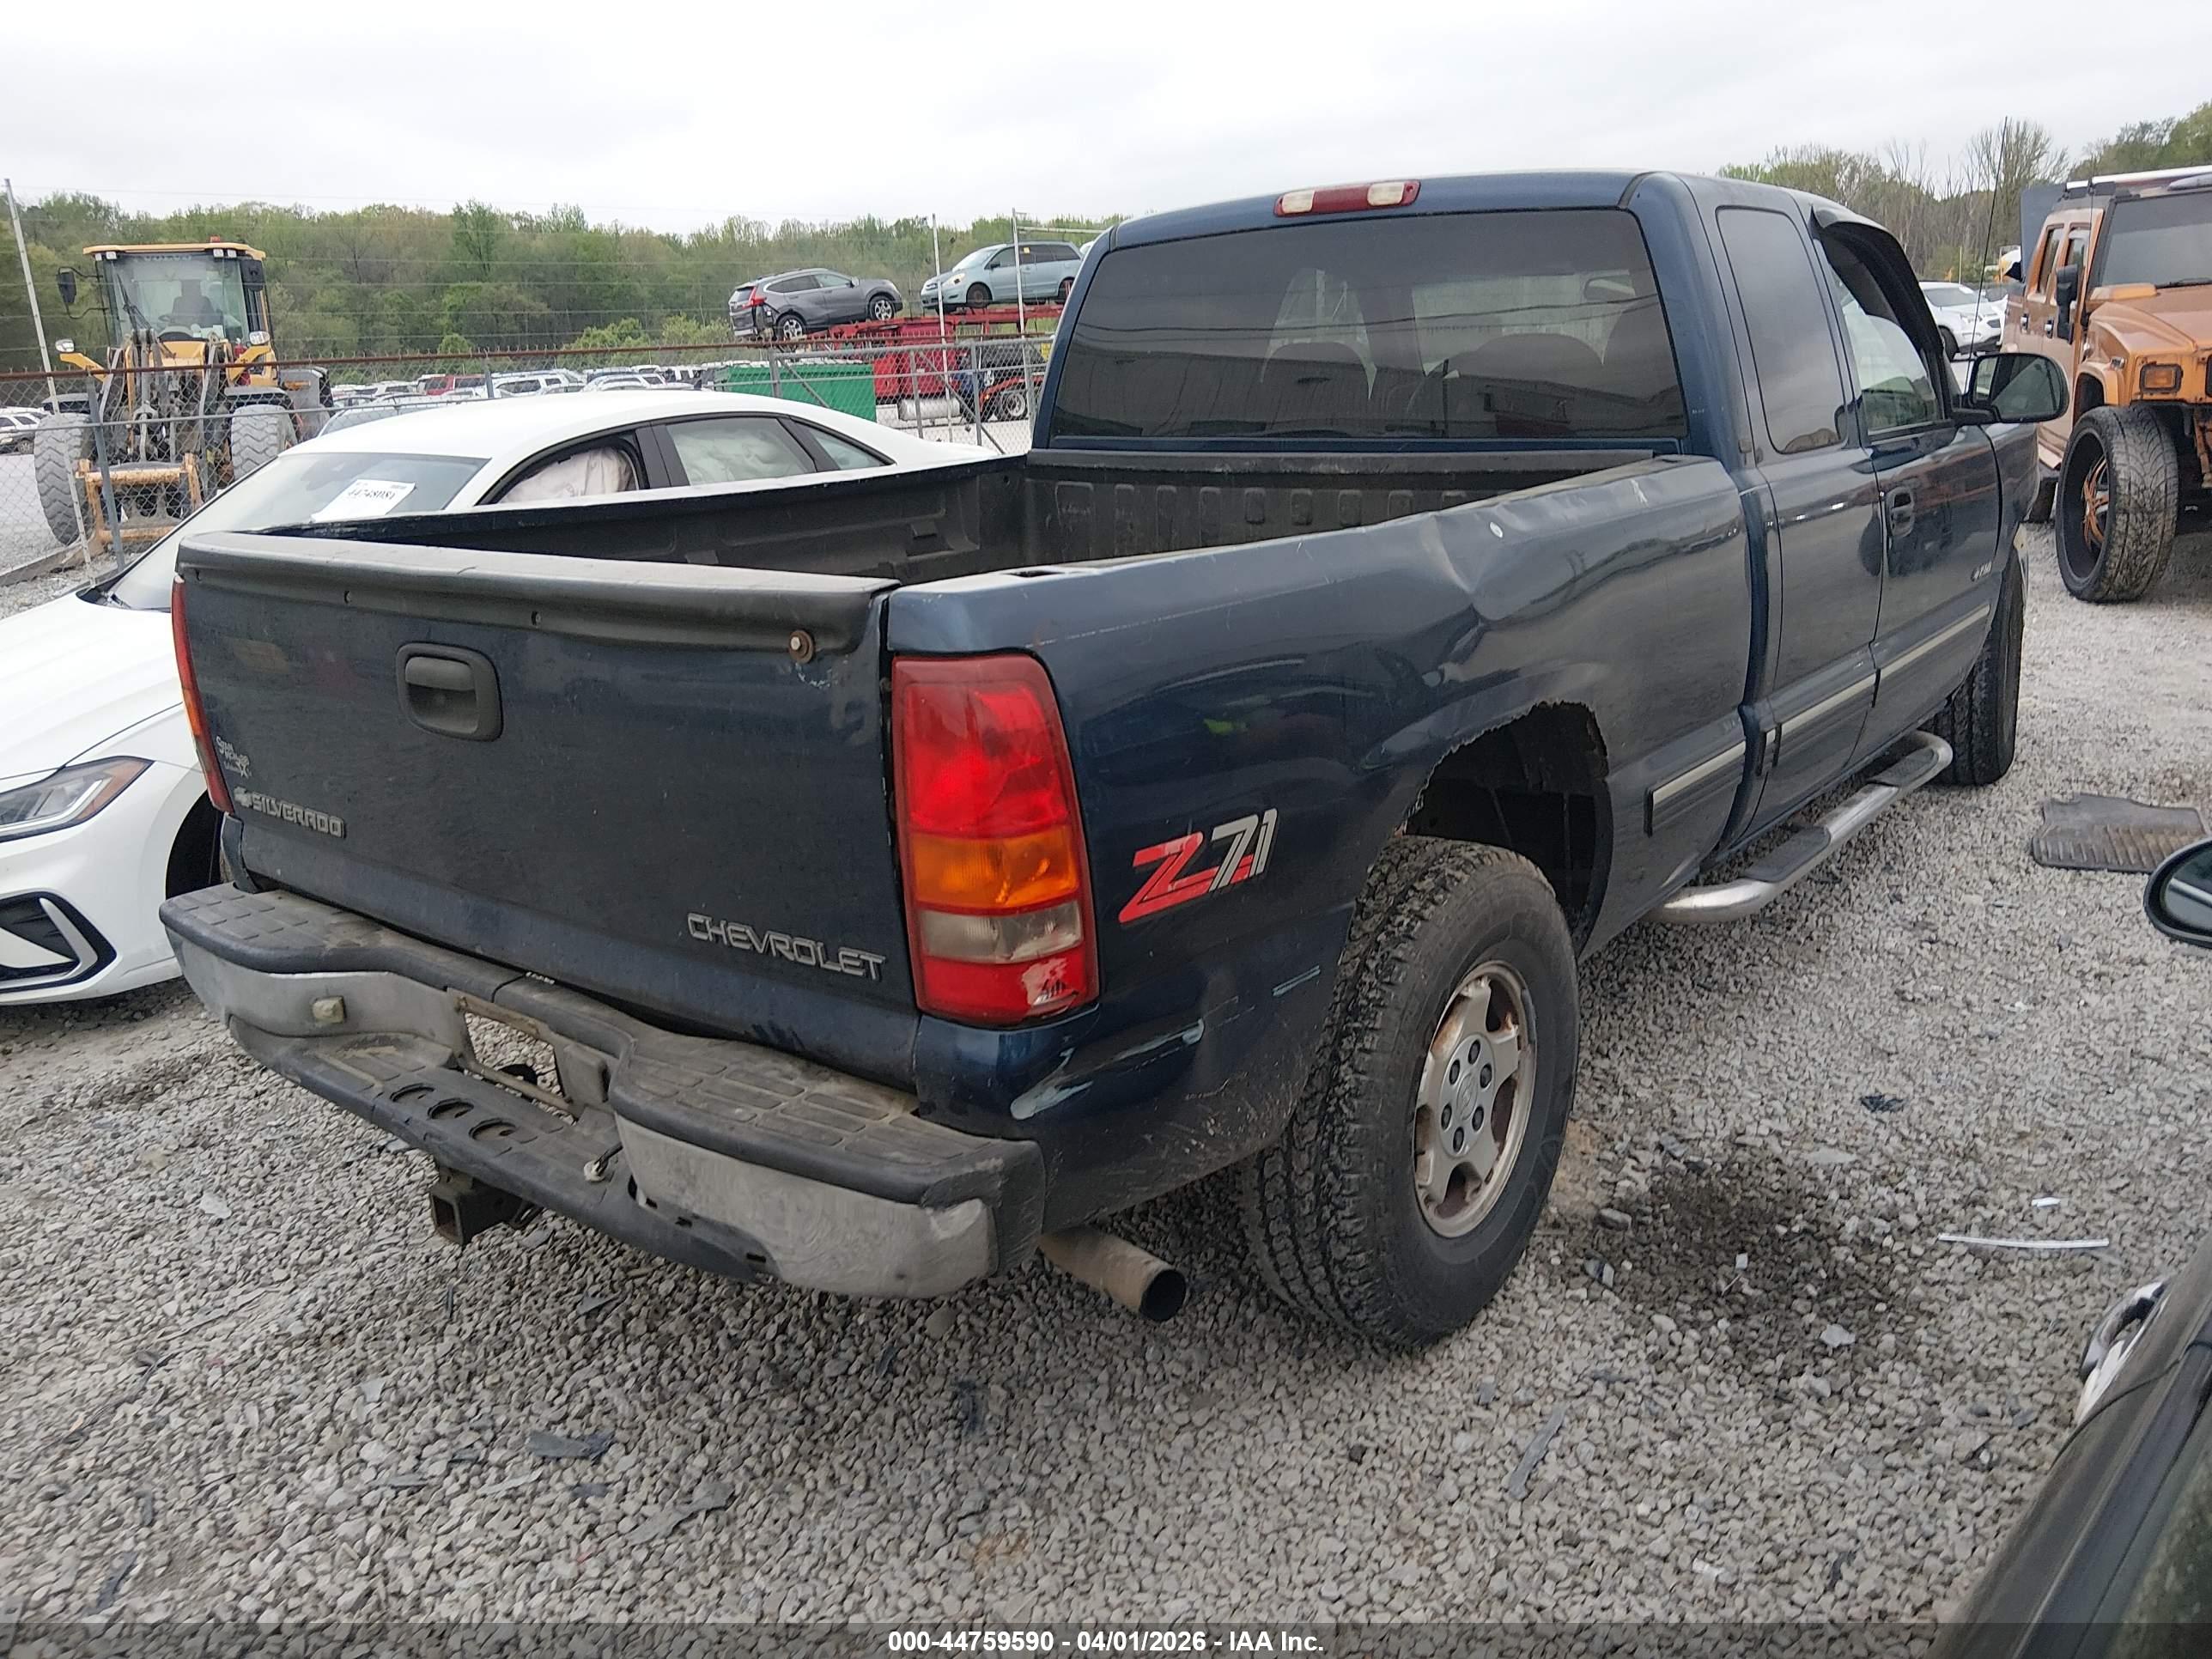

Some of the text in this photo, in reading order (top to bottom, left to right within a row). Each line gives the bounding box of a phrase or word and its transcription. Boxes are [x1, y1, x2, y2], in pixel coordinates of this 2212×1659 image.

[252, 792, 345, 837] SILVERADO
[1118, 808, 1279, 924] Z71
[687, 912, 886, 981] CHEVROLET
